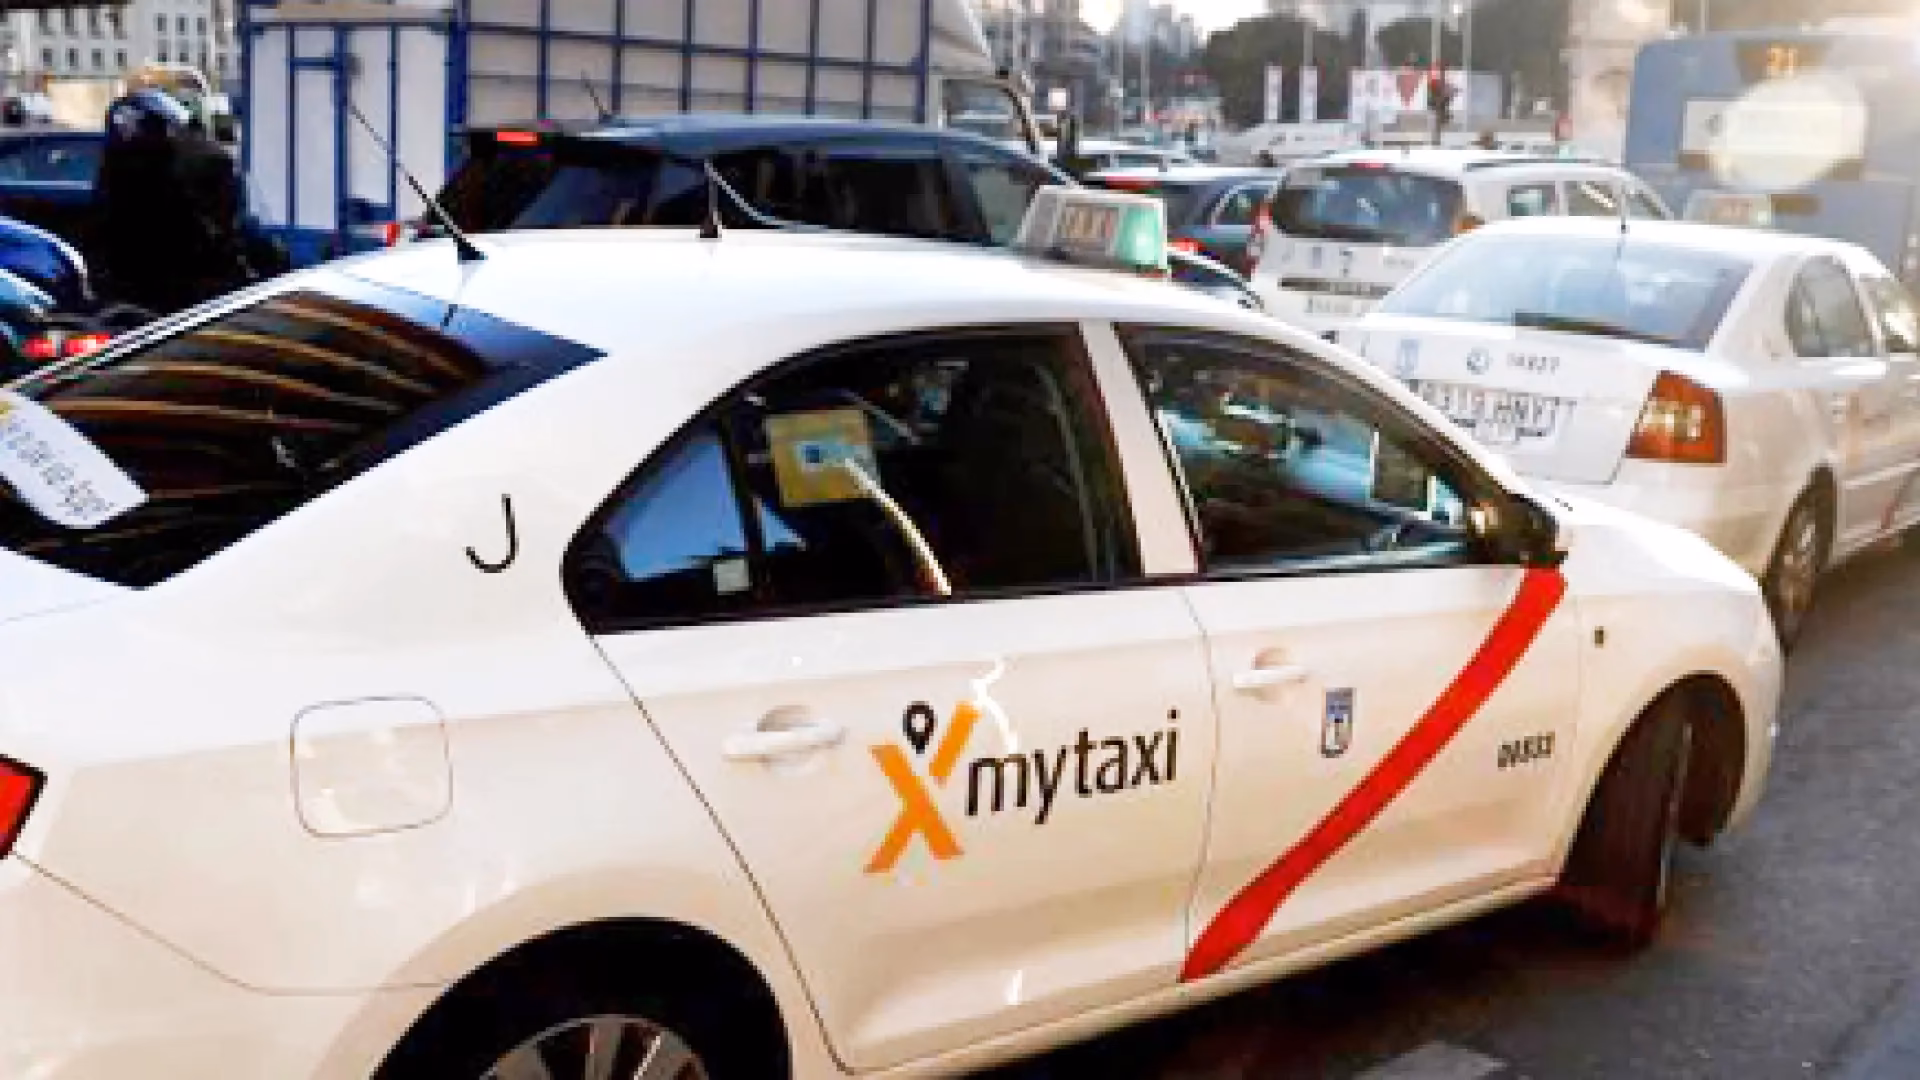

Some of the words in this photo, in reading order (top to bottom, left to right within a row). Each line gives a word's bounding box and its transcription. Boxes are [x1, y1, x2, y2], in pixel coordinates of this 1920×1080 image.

[1057, 204, 1117, 239] TAXI
[464, 493, 520, 574] J
[966, 706, 1180, 825] mytaxi
